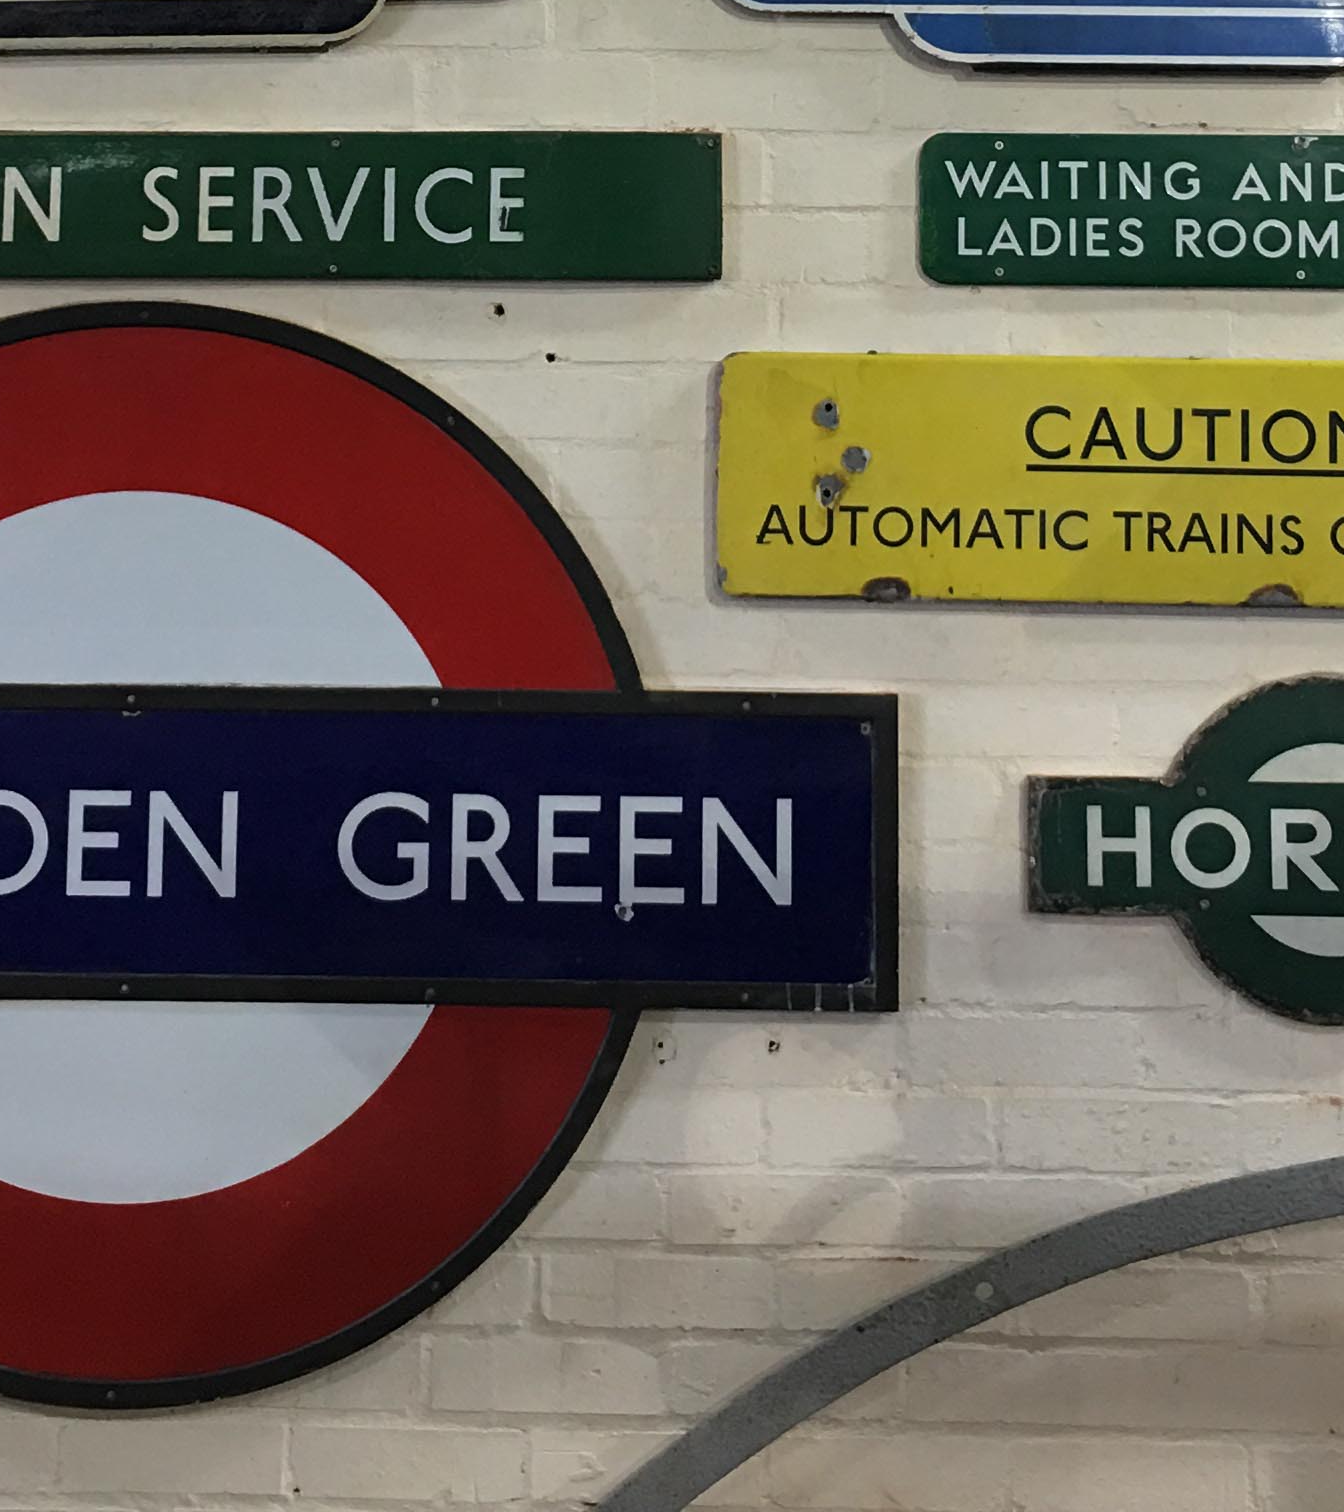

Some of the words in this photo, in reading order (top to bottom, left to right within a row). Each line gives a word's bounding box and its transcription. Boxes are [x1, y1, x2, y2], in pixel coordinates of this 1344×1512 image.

[143, 167, 524, 243] SERVICE
[945, 161, 1200, 200] WAITING
[958, 217, 1143, 256] LADIES
[1176, 219, 1338, 258] ROOM
[756, 505, 1088, 551] AUTOMATIC
[1120, 511, 1304, 555] TRAINS
[337, 792, 793, 906] GREEN
